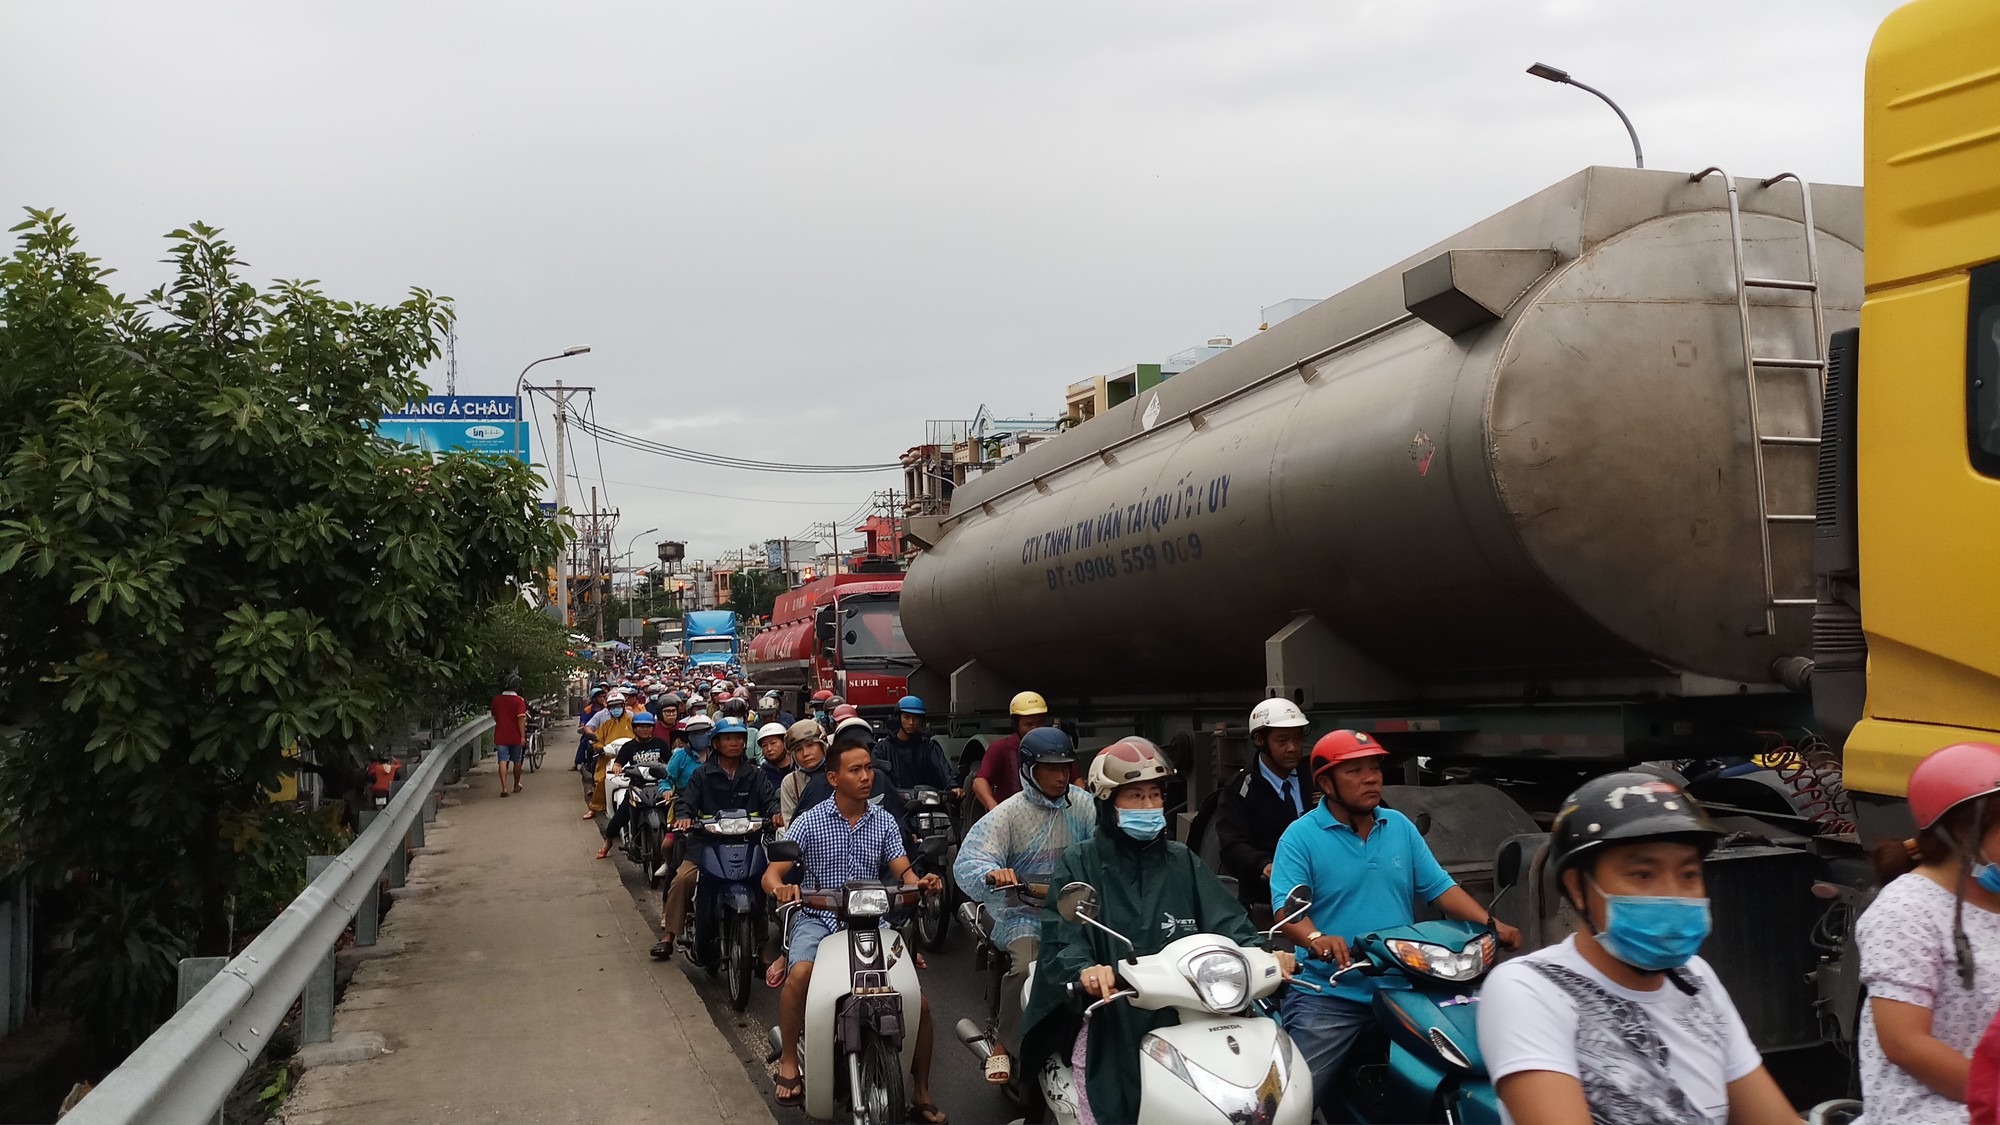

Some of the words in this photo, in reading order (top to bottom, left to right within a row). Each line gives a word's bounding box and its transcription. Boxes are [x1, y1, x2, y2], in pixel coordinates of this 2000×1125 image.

[464, 399, 509, 415] CHÂU
[1022, 534, 1043, 565] CTY
[1044, 523, 1073, 559] TNHH
[1076, 519, 1094, 550] TM
[1120, 543, 1157, 576] 559
[849, 679, 879, 687] SUPER
